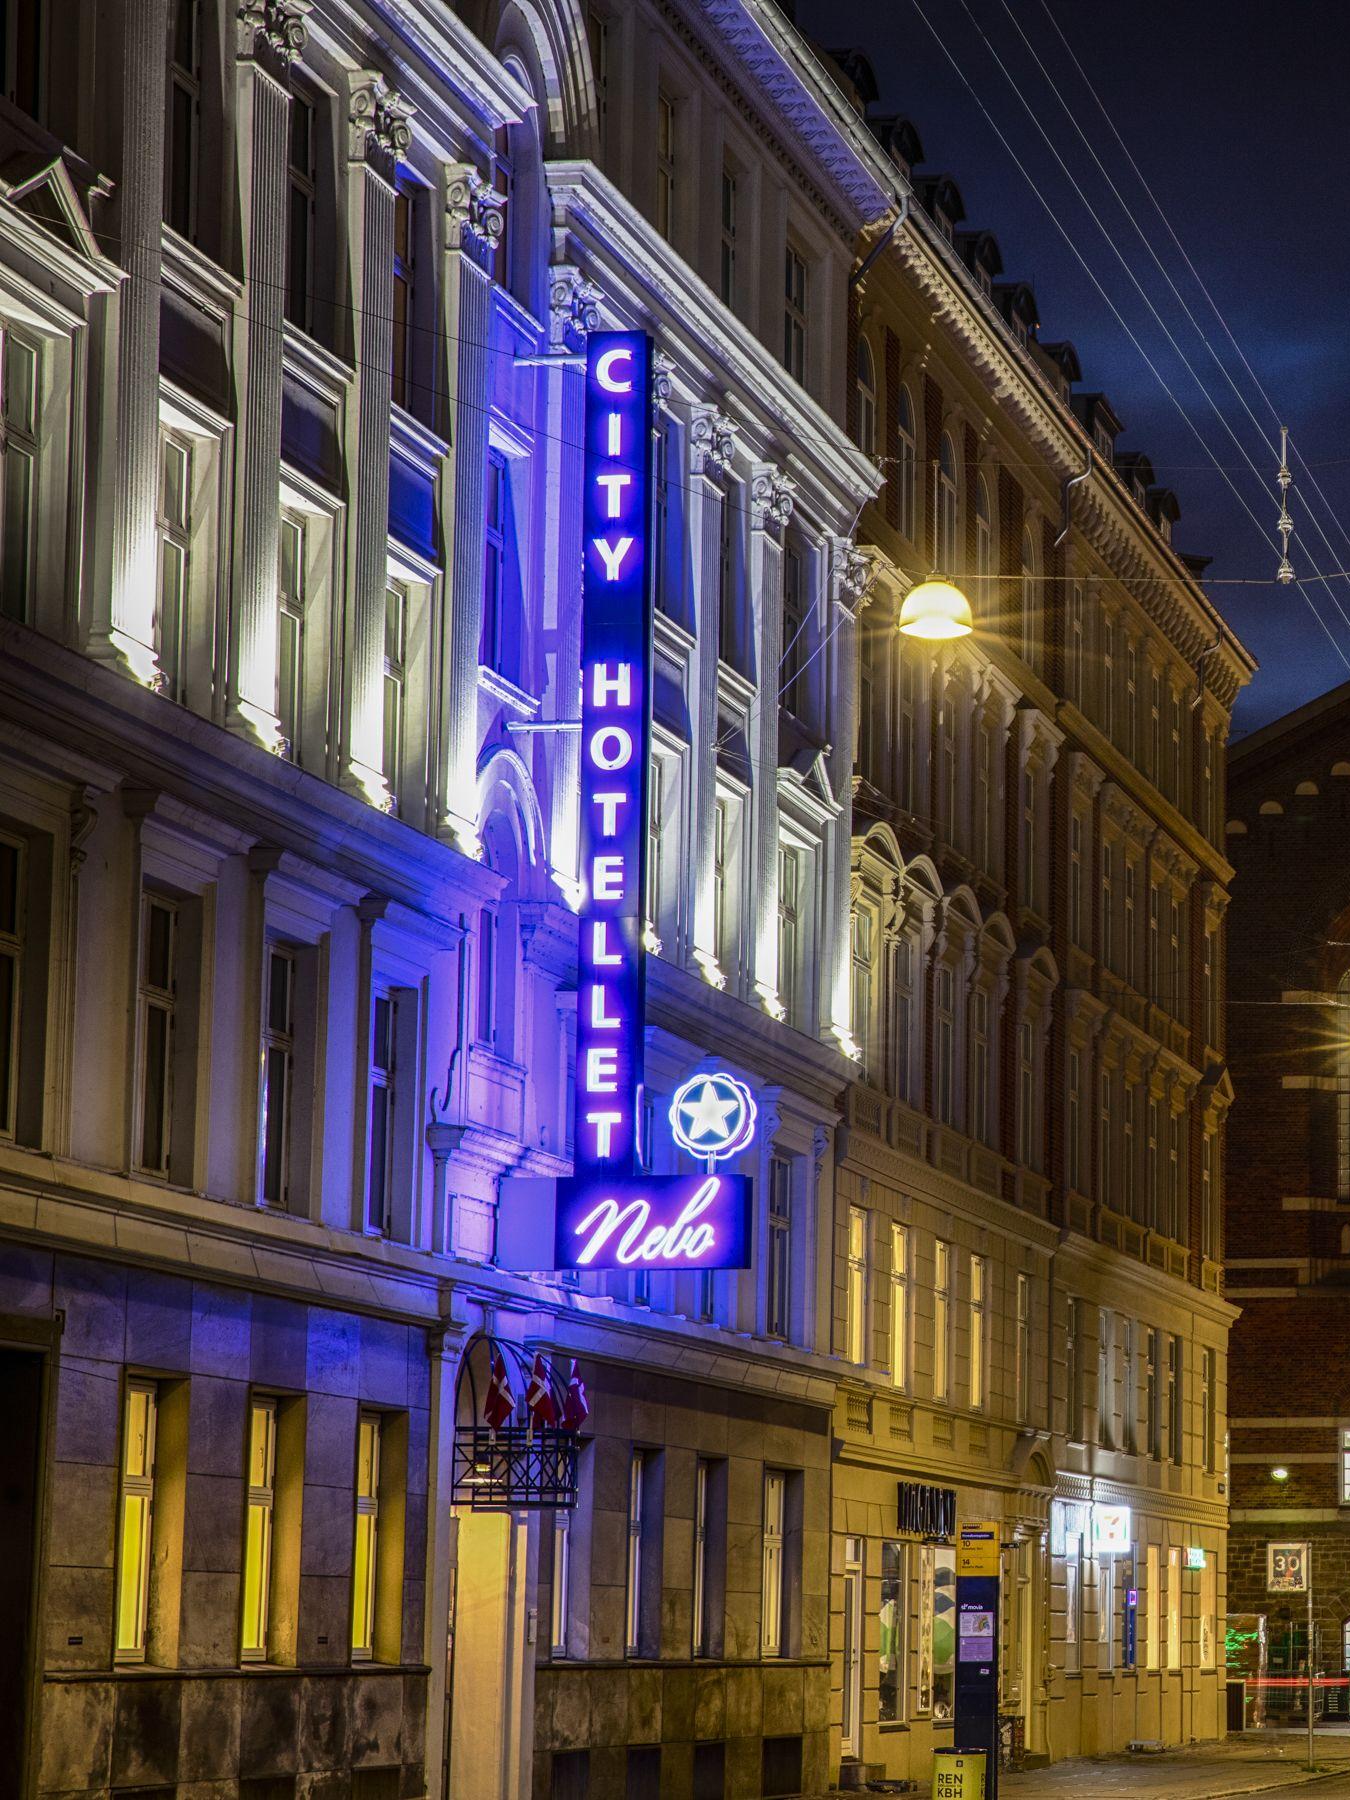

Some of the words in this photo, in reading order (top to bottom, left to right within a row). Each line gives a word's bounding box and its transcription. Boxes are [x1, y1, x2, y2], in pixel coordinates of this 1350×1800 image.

[593, 349, 634, 581] CITY
[586, 663, 633, 1158] HOTELLET
[574, 1176, 721, 1264] Nebo
[1274, 1555, 1300, 1571] 30
[937, 1788, 963, 1798] KBH
[938, 1773, 963, 1784] REN
